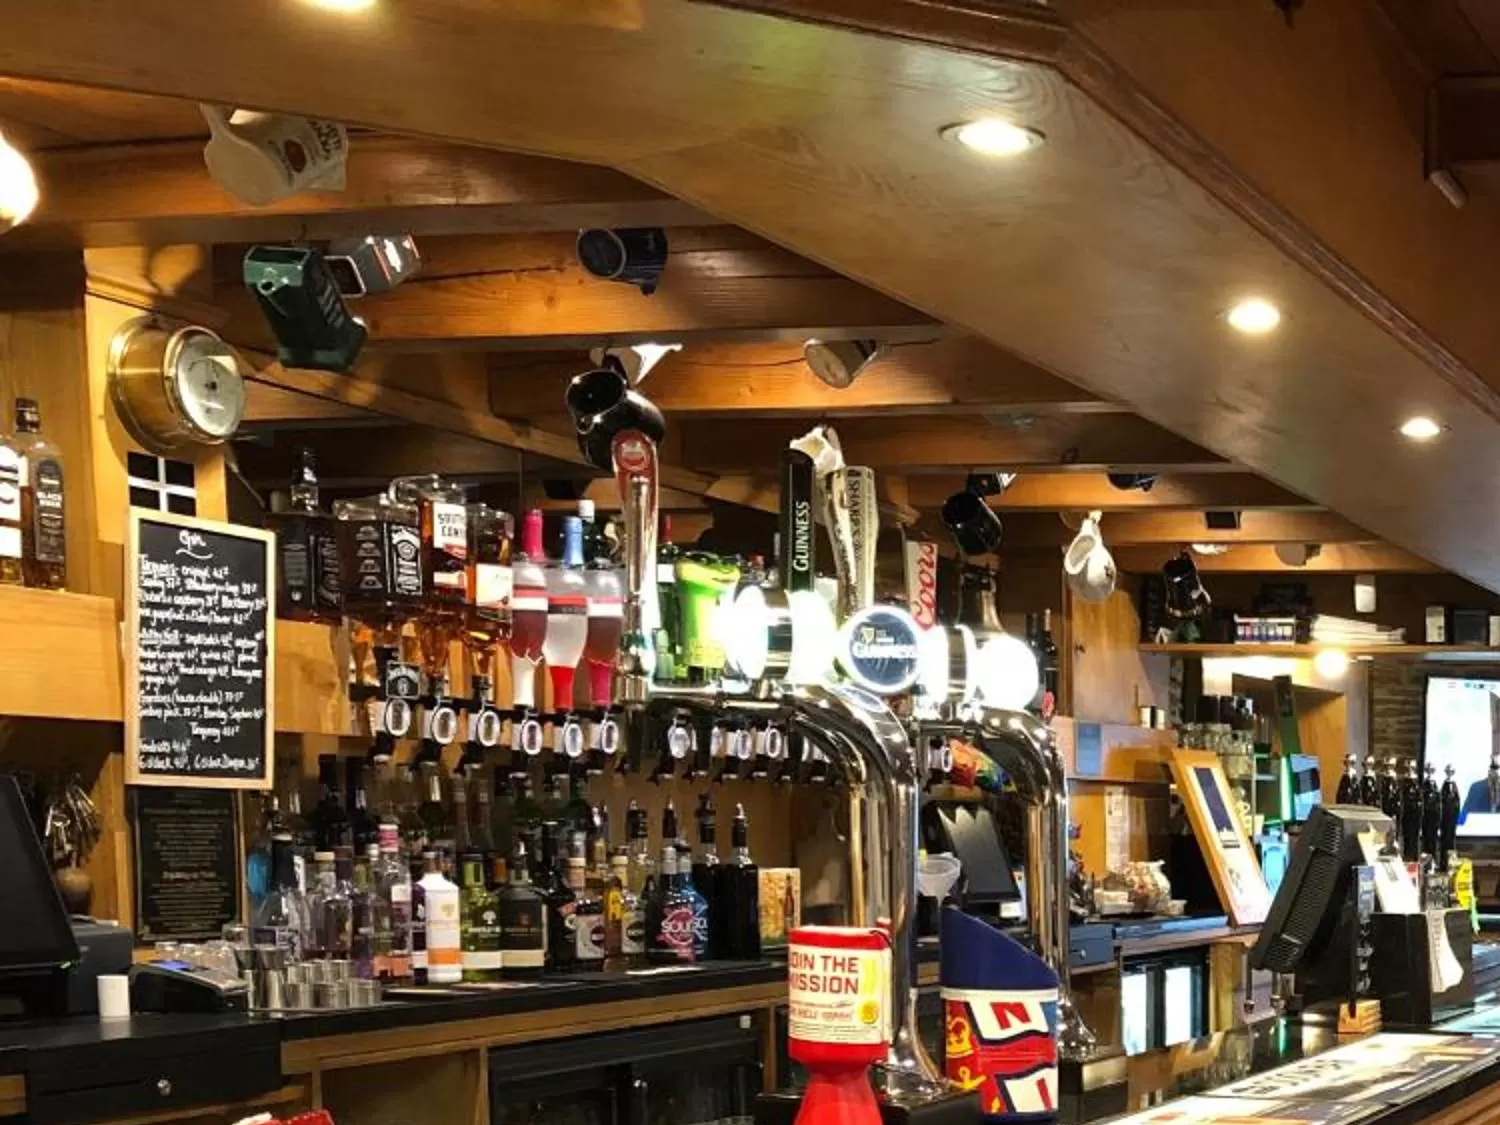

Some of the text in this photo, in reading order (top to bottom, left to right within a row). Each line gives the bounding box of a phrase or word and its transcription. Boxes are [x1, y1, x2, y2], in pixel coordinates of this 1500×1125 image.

[793, 501, 811, 572] GUINNESS
[911, 543, 937, 630] Coors
[820, 955, 859, 973] THE
